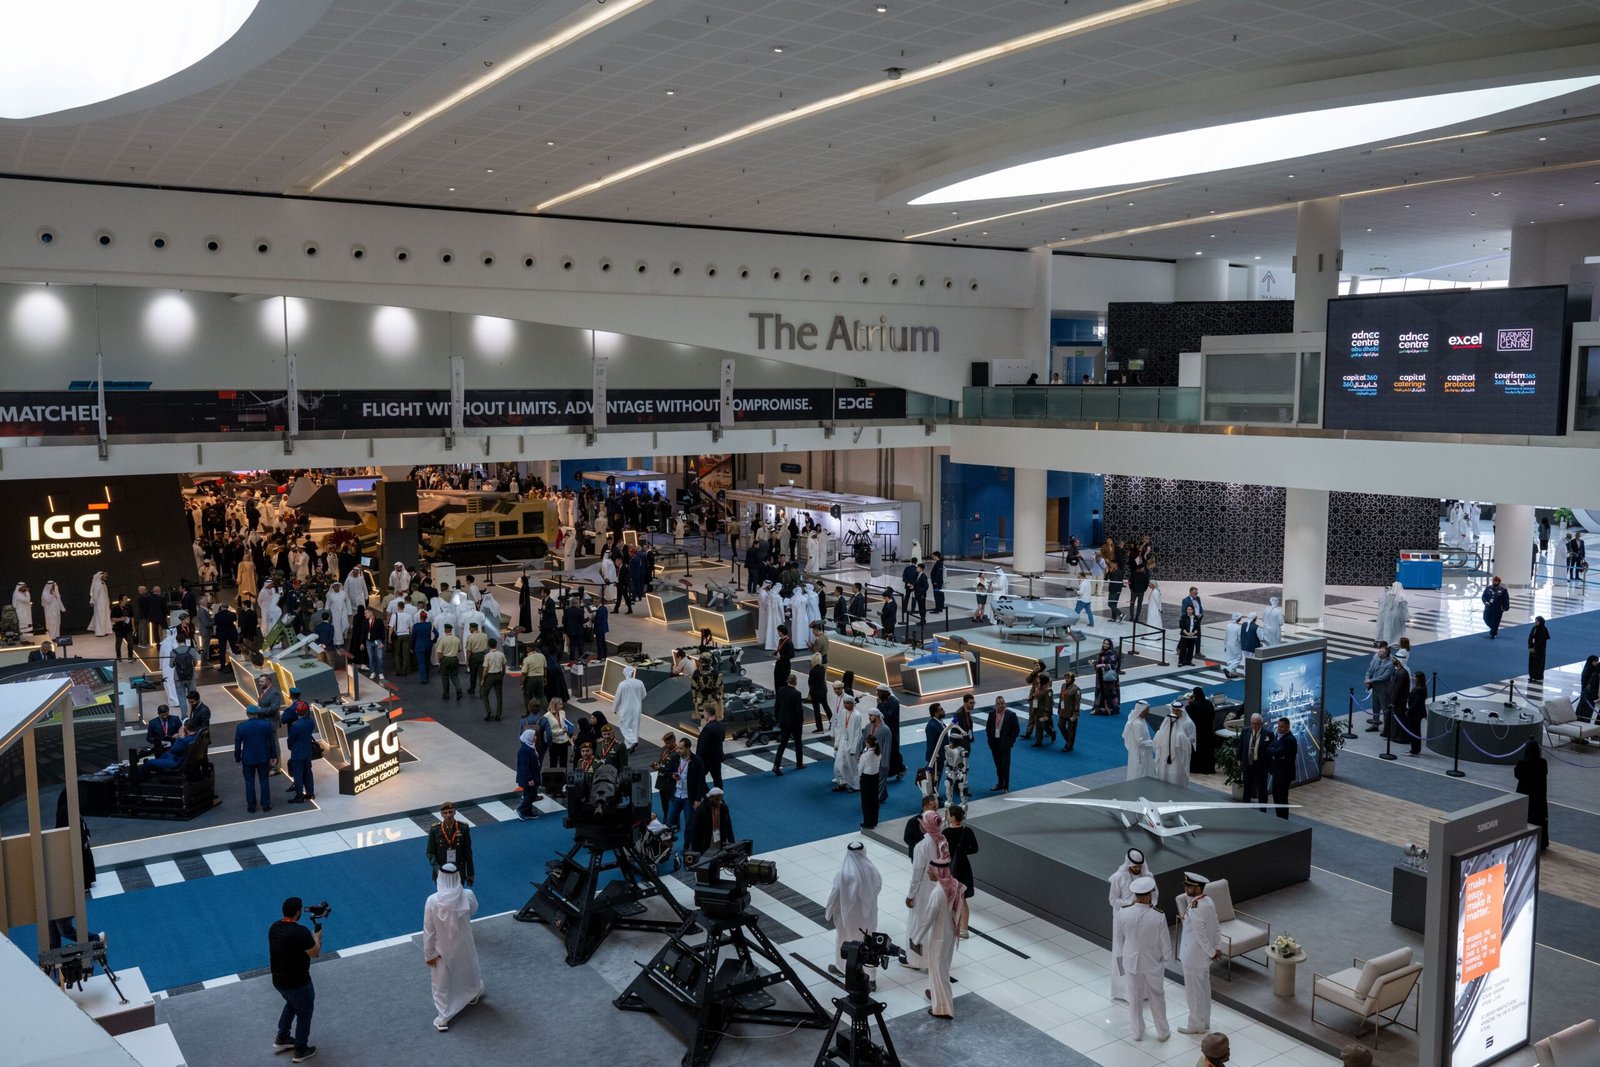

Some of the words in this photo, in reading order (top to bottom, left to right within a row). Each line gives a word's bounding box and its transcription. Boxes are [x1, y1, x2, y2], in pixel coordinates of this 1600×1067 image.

[748, 312, 818, 350] The
[825, 315, 940, 352] Atrium
[1448, 332, 1482, 345] excel
[1400, 374, 1426, 382] capital
[363, 402, 425, 417] FLIGHT
[426, 402, 505, 416] WIHOUT
[509, 401, 561, 415] LIMITS.
[565, 400, 653, 414] ADVNTAGE
[656, 399, 720, 413] WITHOUT
[733, 398, 812, 411] OMPROMISE.
[838, 398, 873, 409] EDGE
[29, 514, 101, 541] IGG
[31, 541, 100, 550] INTERNATIONAL
[32, 551, 69, 559] GOLDEN
[70, 548, 101, 557] GROUP
[353, 722, 399, 771] IGG
[354, 757, 399, 783] INTERNATIONAL
[355, 776, 379, 793] GOLDEN
[379, 766, 400, 781] GROUP
[1468, 878, 1487, 891] make
[1487, 874, 1492, 883] it
[1467, 897, 1485, 912] make
[1486, 894, 1491, 903] it
[1468, 889, 1484, 902] easy.
[1467, 907, 1490, 922] matter.
